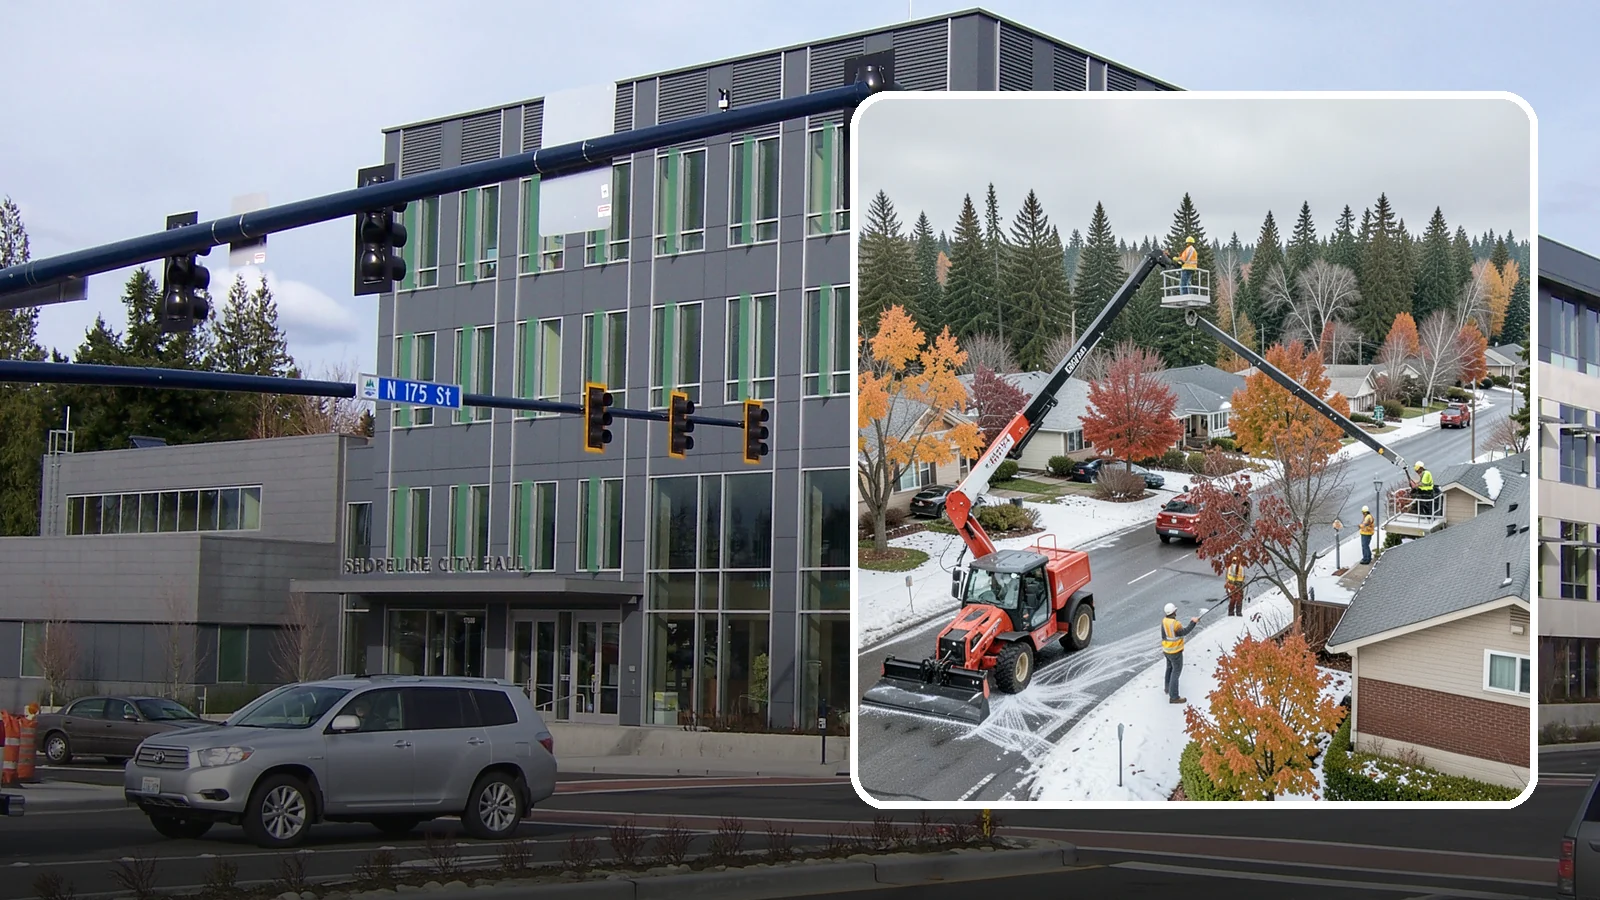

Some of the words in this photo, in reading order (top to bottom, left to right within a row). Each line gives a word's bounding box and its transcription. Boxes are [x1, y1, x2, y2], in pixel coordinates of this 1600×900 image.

[387, 380, 396, 399] N
[405, 382, 427, 403] 175
[436, 386, 452, 406] St
[344, 557, 432, 574] SHORELINE
[438, 556, 475, 572] CITY
[483, 555, 525, 572] HALL
